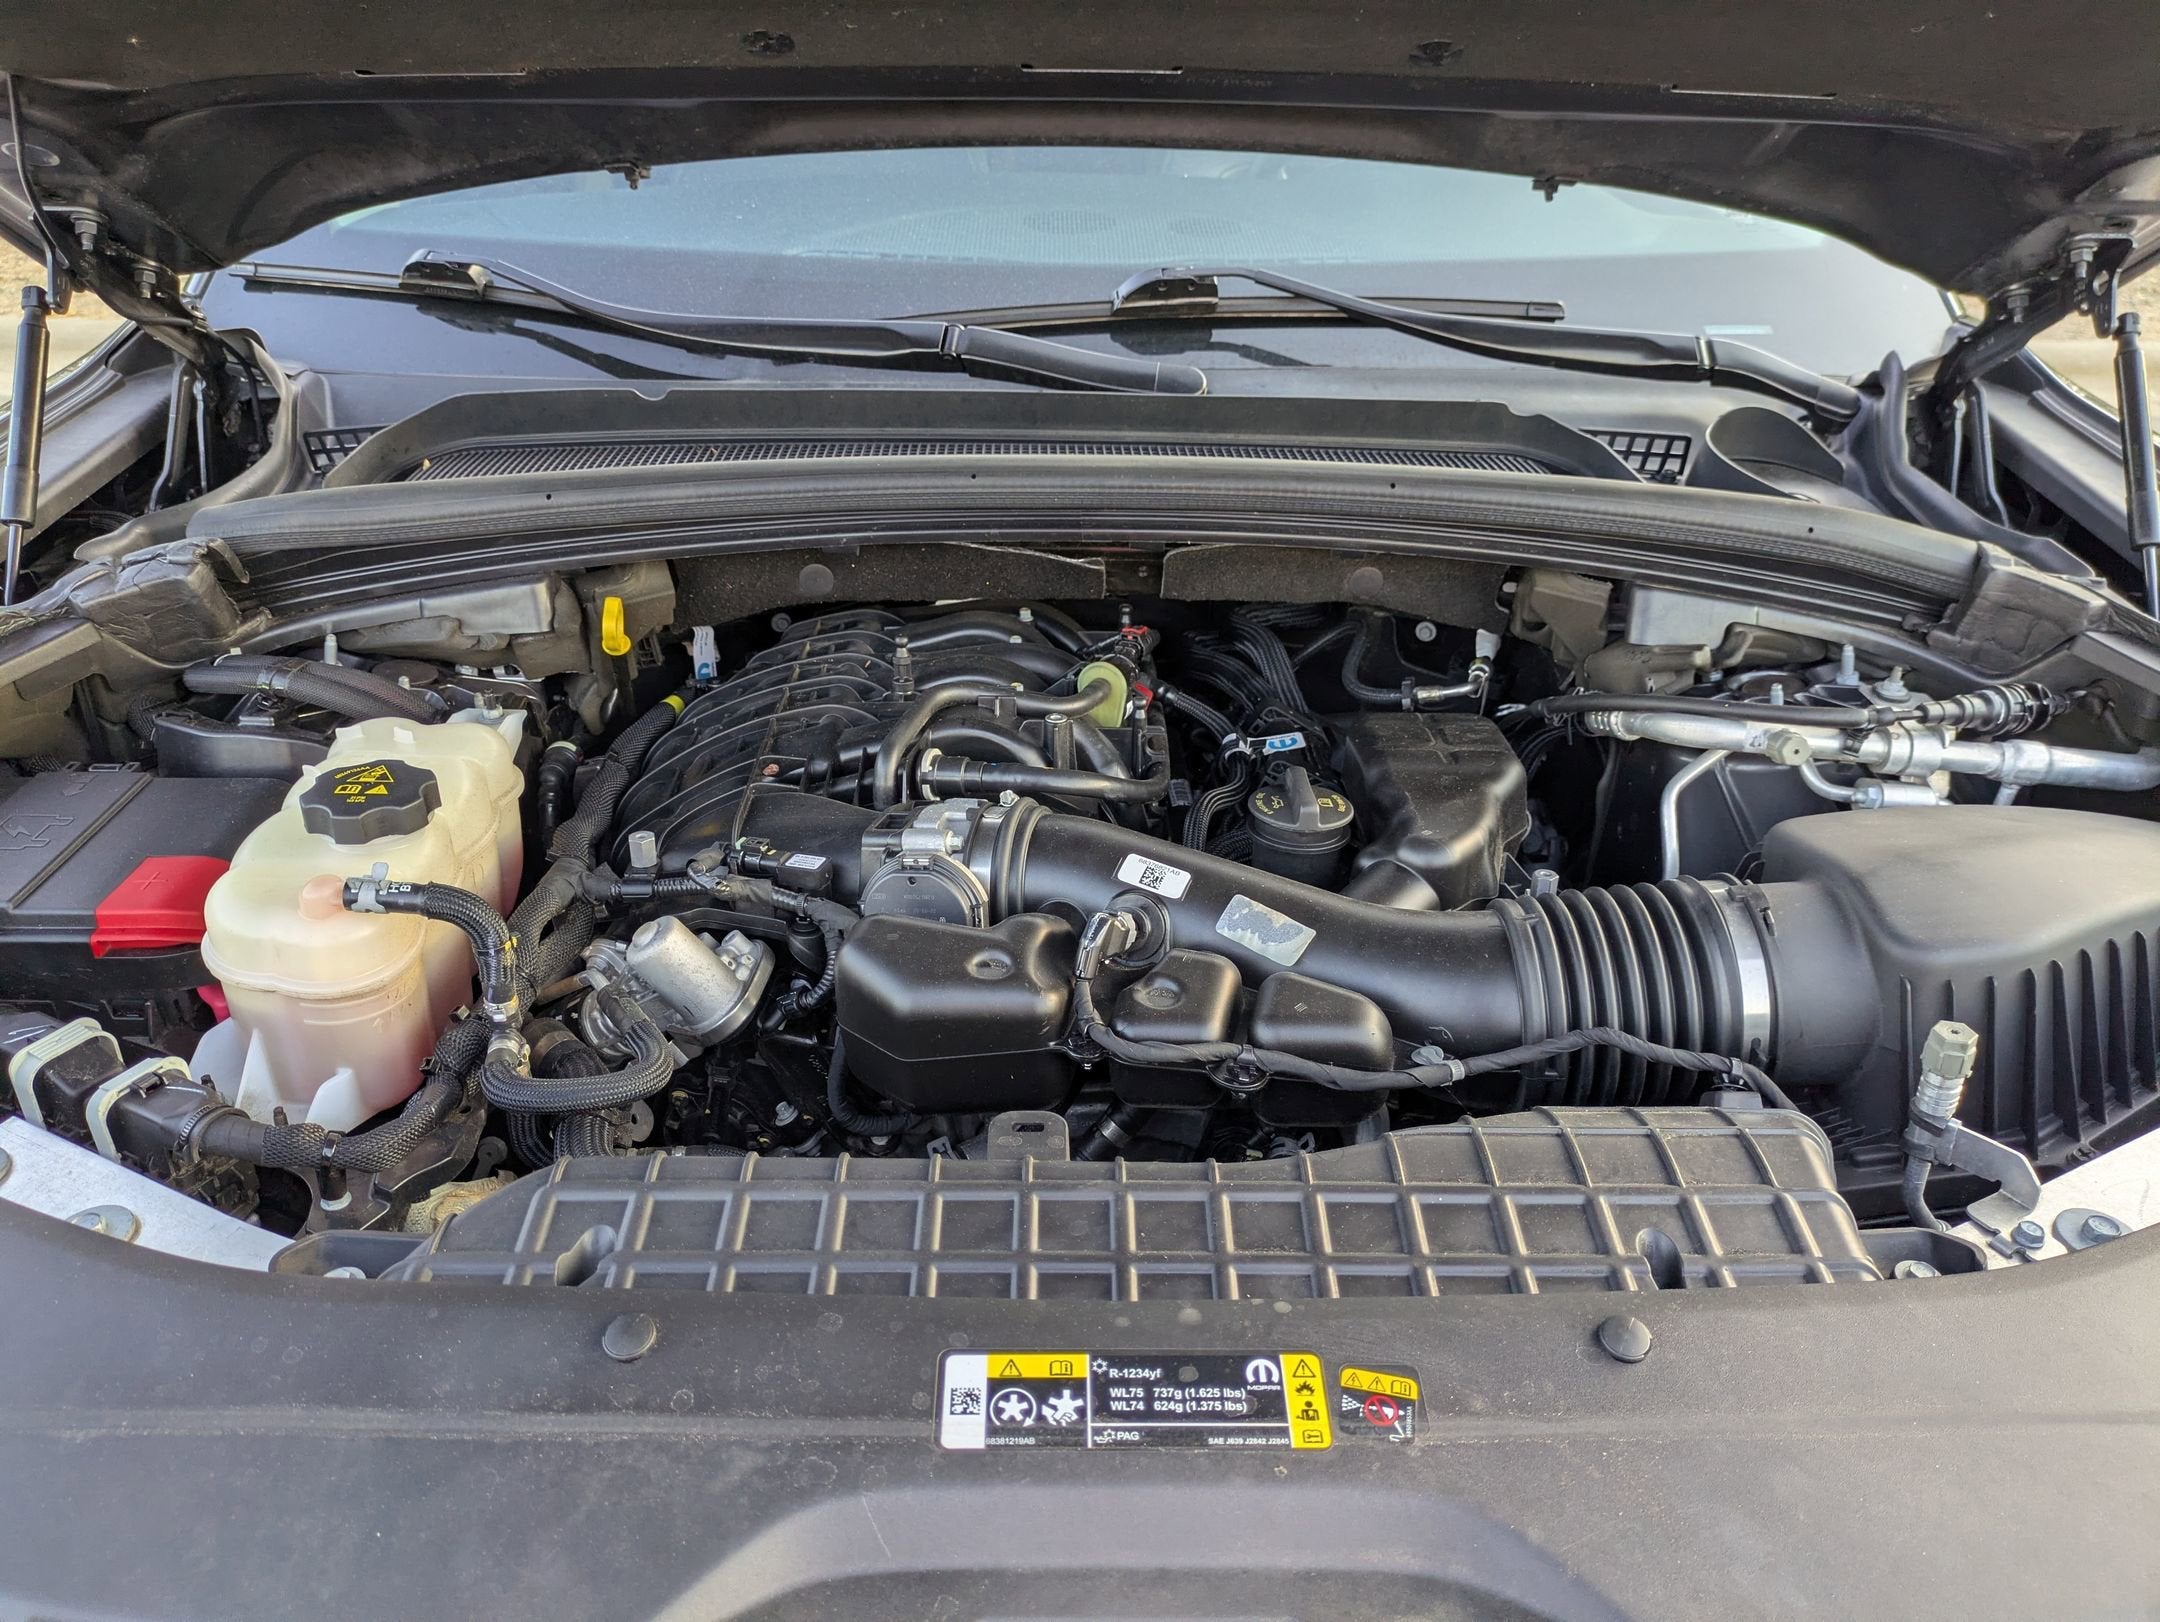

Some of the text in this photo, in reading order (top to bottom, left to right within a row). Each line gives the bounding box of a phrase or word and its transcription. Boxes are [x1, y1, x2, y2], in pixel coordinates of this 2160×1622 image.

[1109, 1368, 1161, 1380] R-1234yf
[1109, 1387, 1246, 1400] WL75 737g (1.625 lbs)
[1110, 1401, 1248, 1412] WL74 624g (1.375 lbs)
[1117, 1431, 1140, 1441] PAG
[1208, 1437, 1225, 1445] SAE
